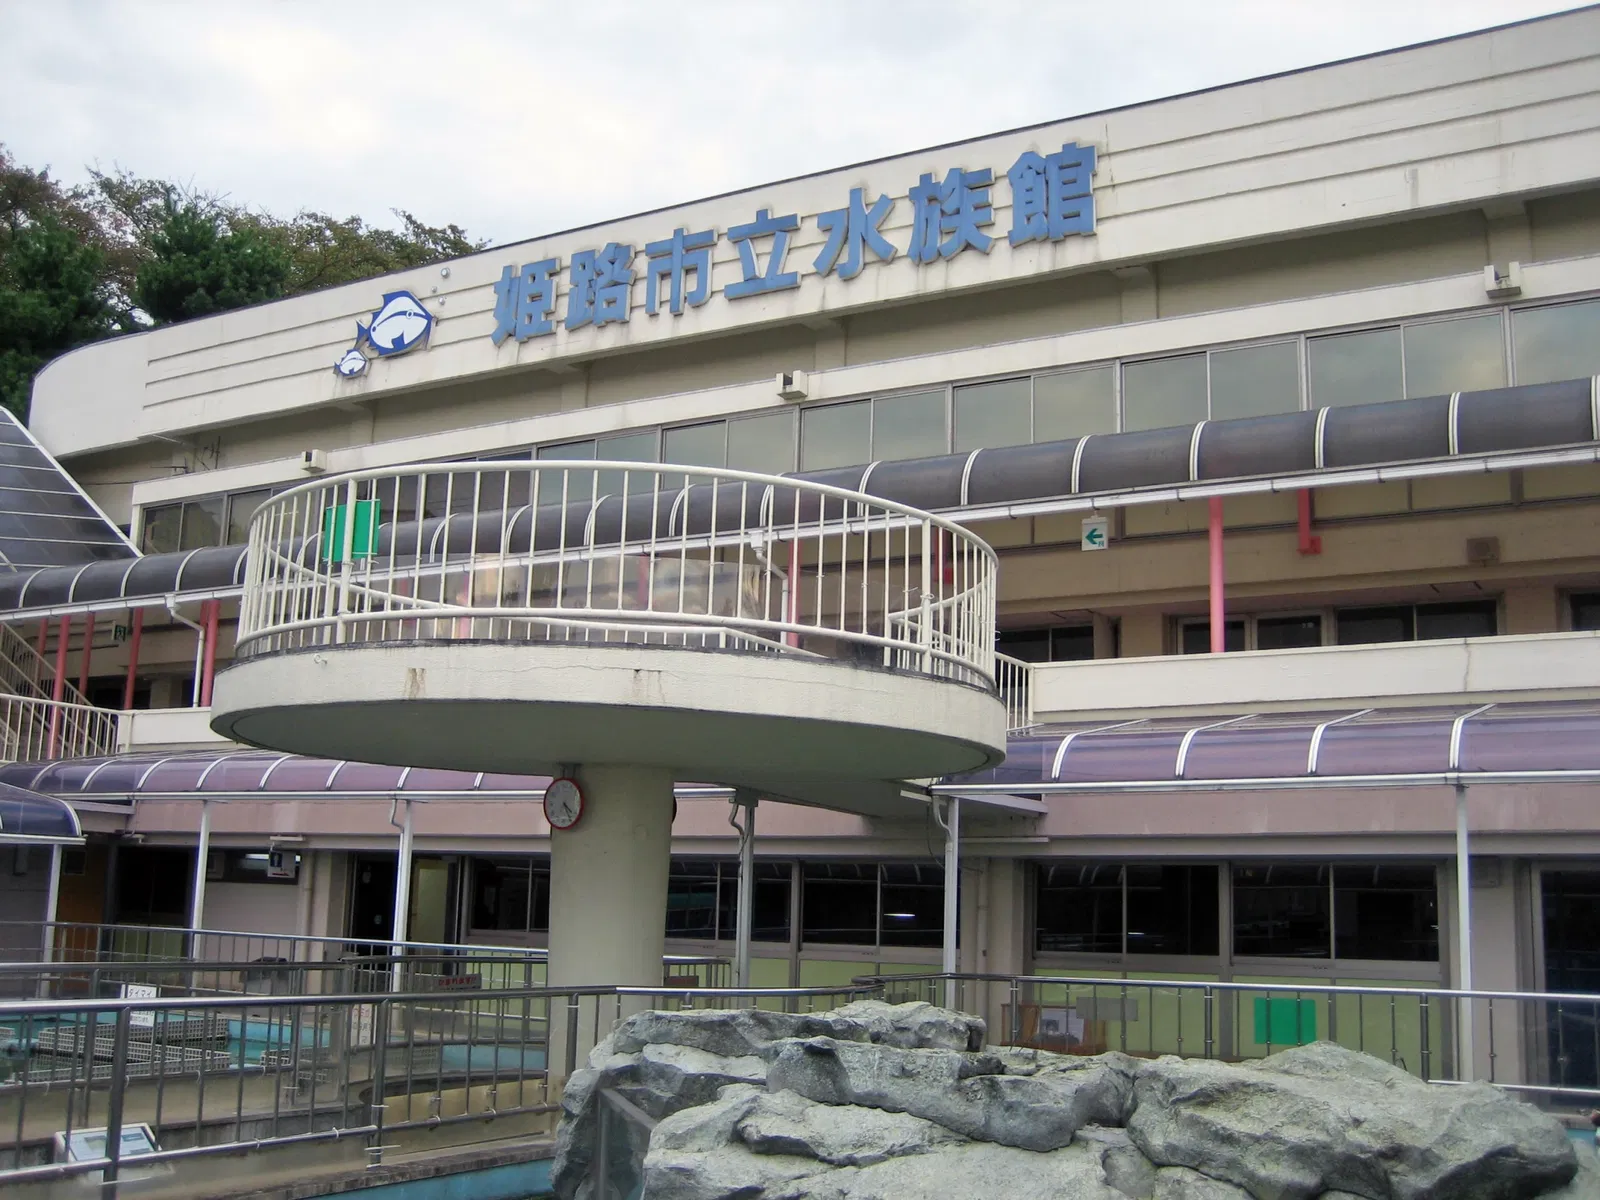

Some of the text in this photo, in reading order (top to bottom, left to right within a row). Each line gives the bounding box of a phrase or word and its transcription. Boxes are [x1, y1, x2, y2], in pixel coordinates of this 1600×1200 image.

[491, 142, 1097, 347] 姫路市立水族館
